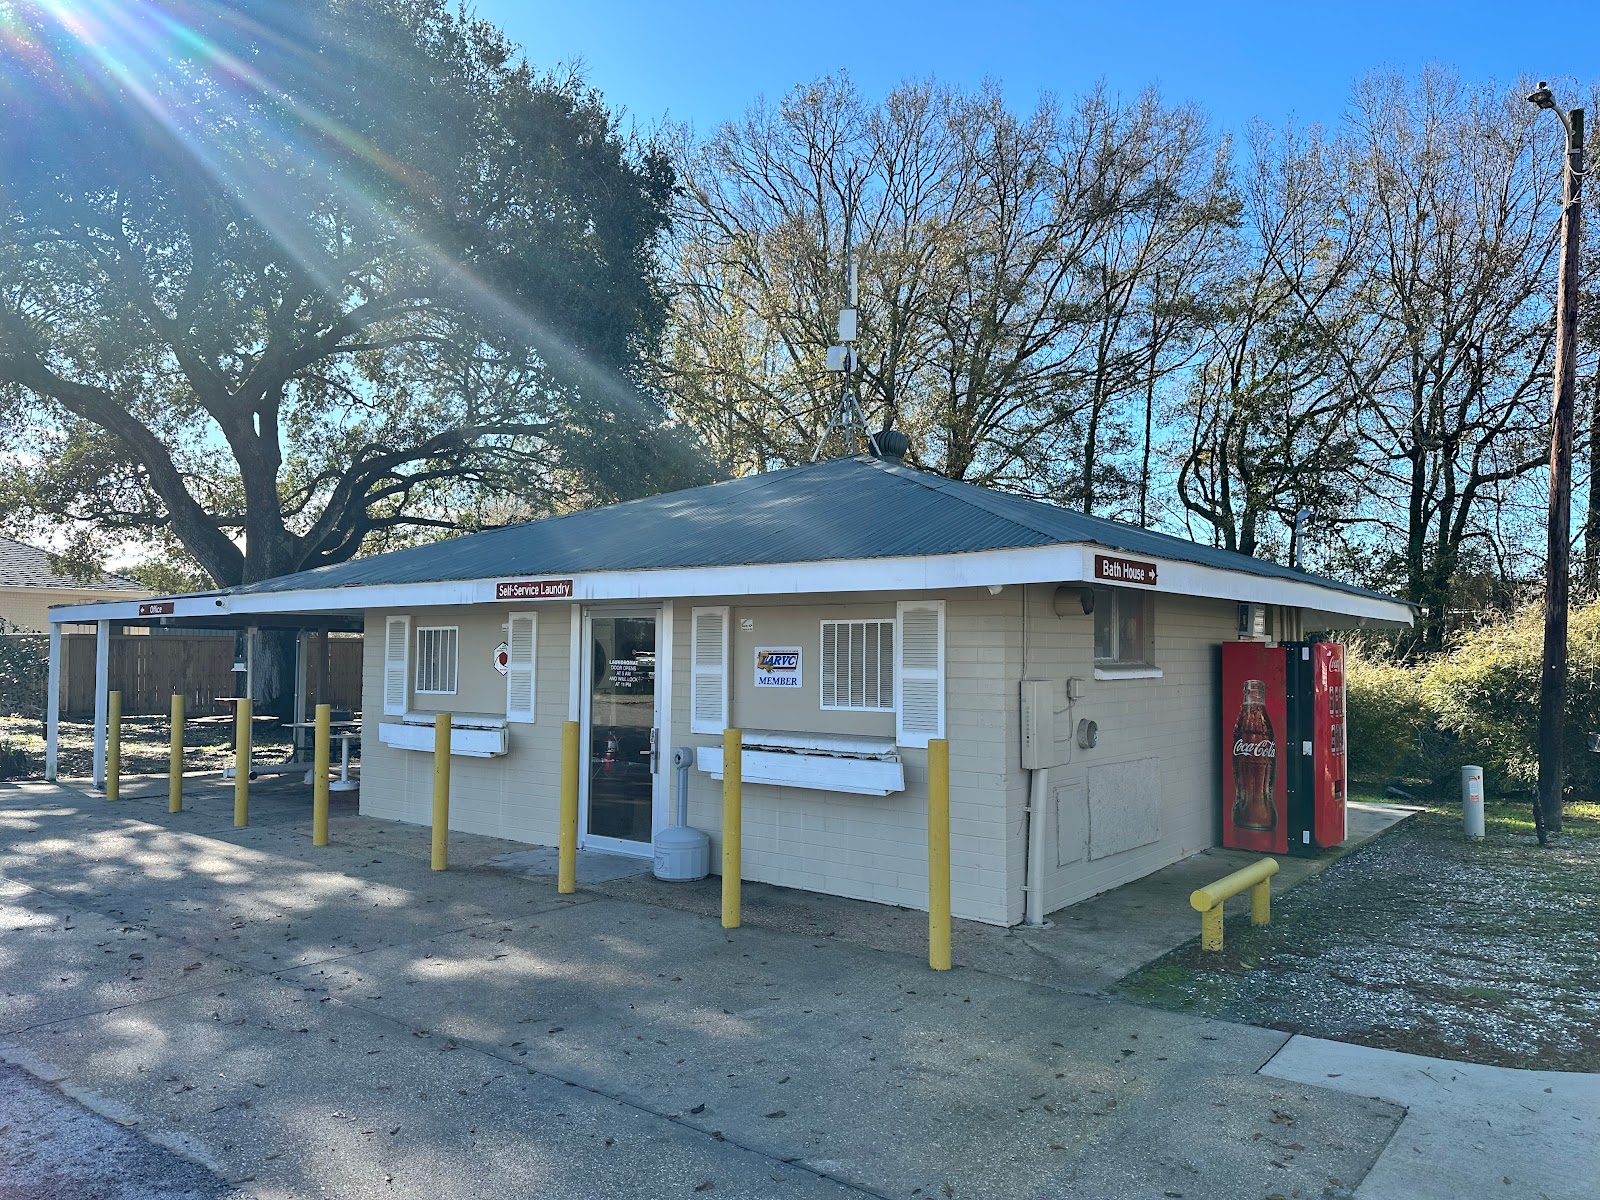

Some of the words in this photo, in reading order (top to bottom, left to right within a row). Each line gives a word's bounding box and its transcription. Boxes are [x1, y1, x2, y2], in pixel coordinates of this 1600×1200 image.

[1102, 560, 1122, 578] Bath
[1123, 562, 1144, 580] House
[499, 584, 539, 596] Self-Service
[540, 583, 570, 597] Laundry
[150, 604, 162, 614] Office
[760, 656, 796, 666] LARVC
[758, 676, 798, 686] MEMBER
